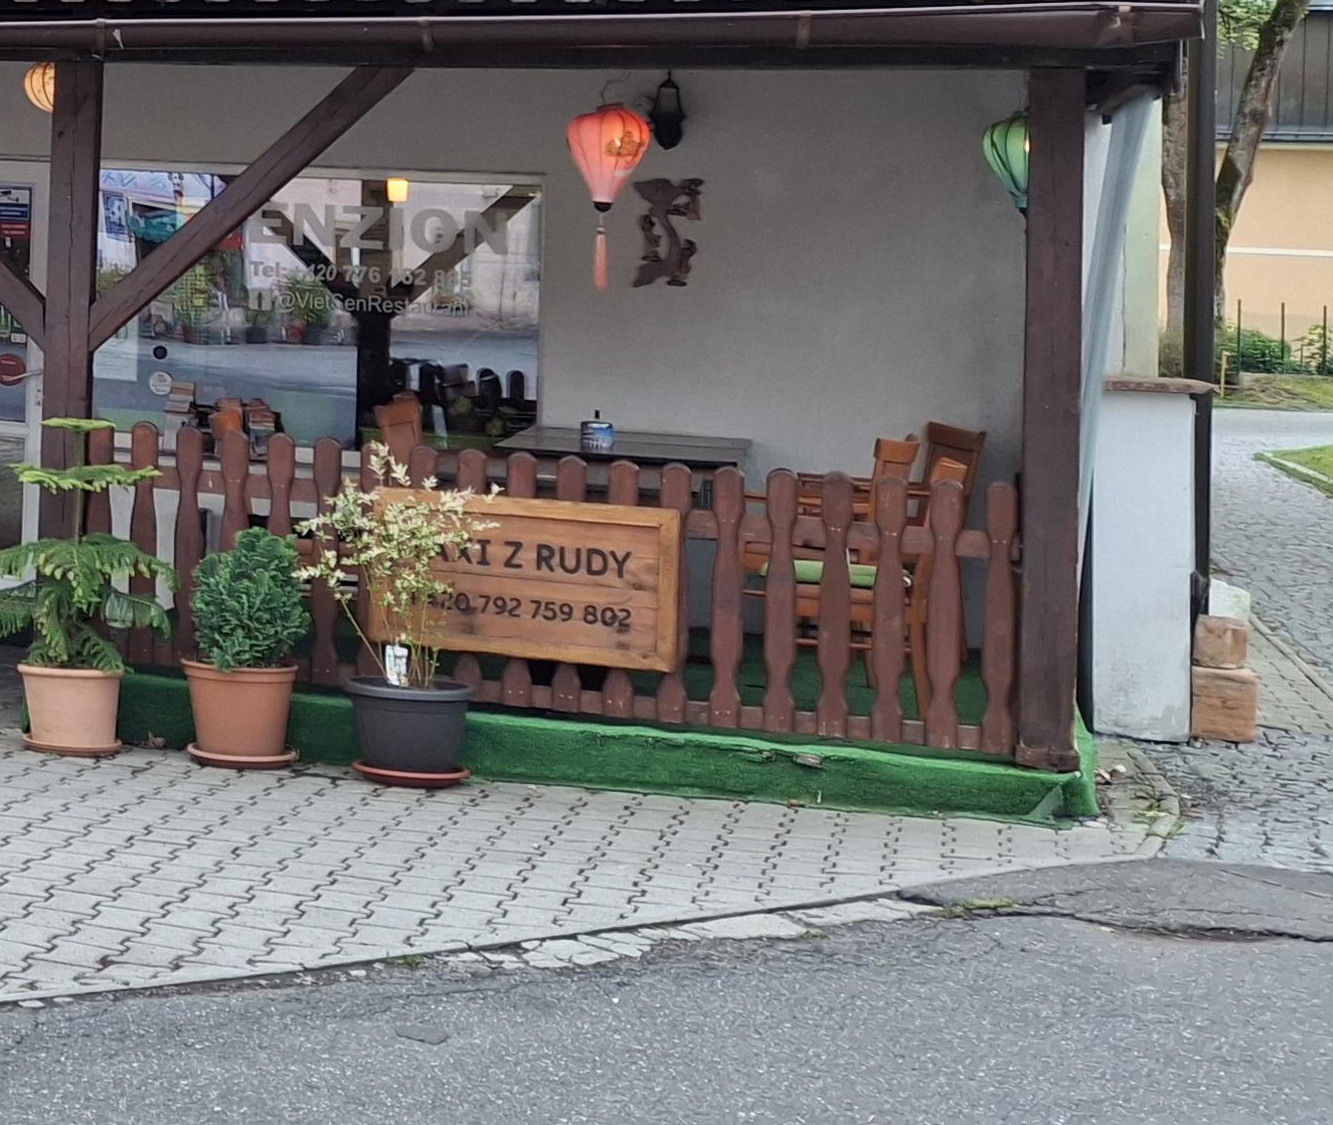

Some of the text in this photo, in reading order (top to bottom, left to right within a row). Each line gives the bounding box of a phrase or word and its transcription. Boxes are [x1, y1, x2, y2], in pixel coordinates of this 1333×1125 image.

[248, 201, 508, 255] ENZION
[432, 539, 632, 578] AXI Z RUDY
[478, 594, 522, 618] 792
[529, 599, 574, 622] 759
[583, 605, 632, 627] 802
